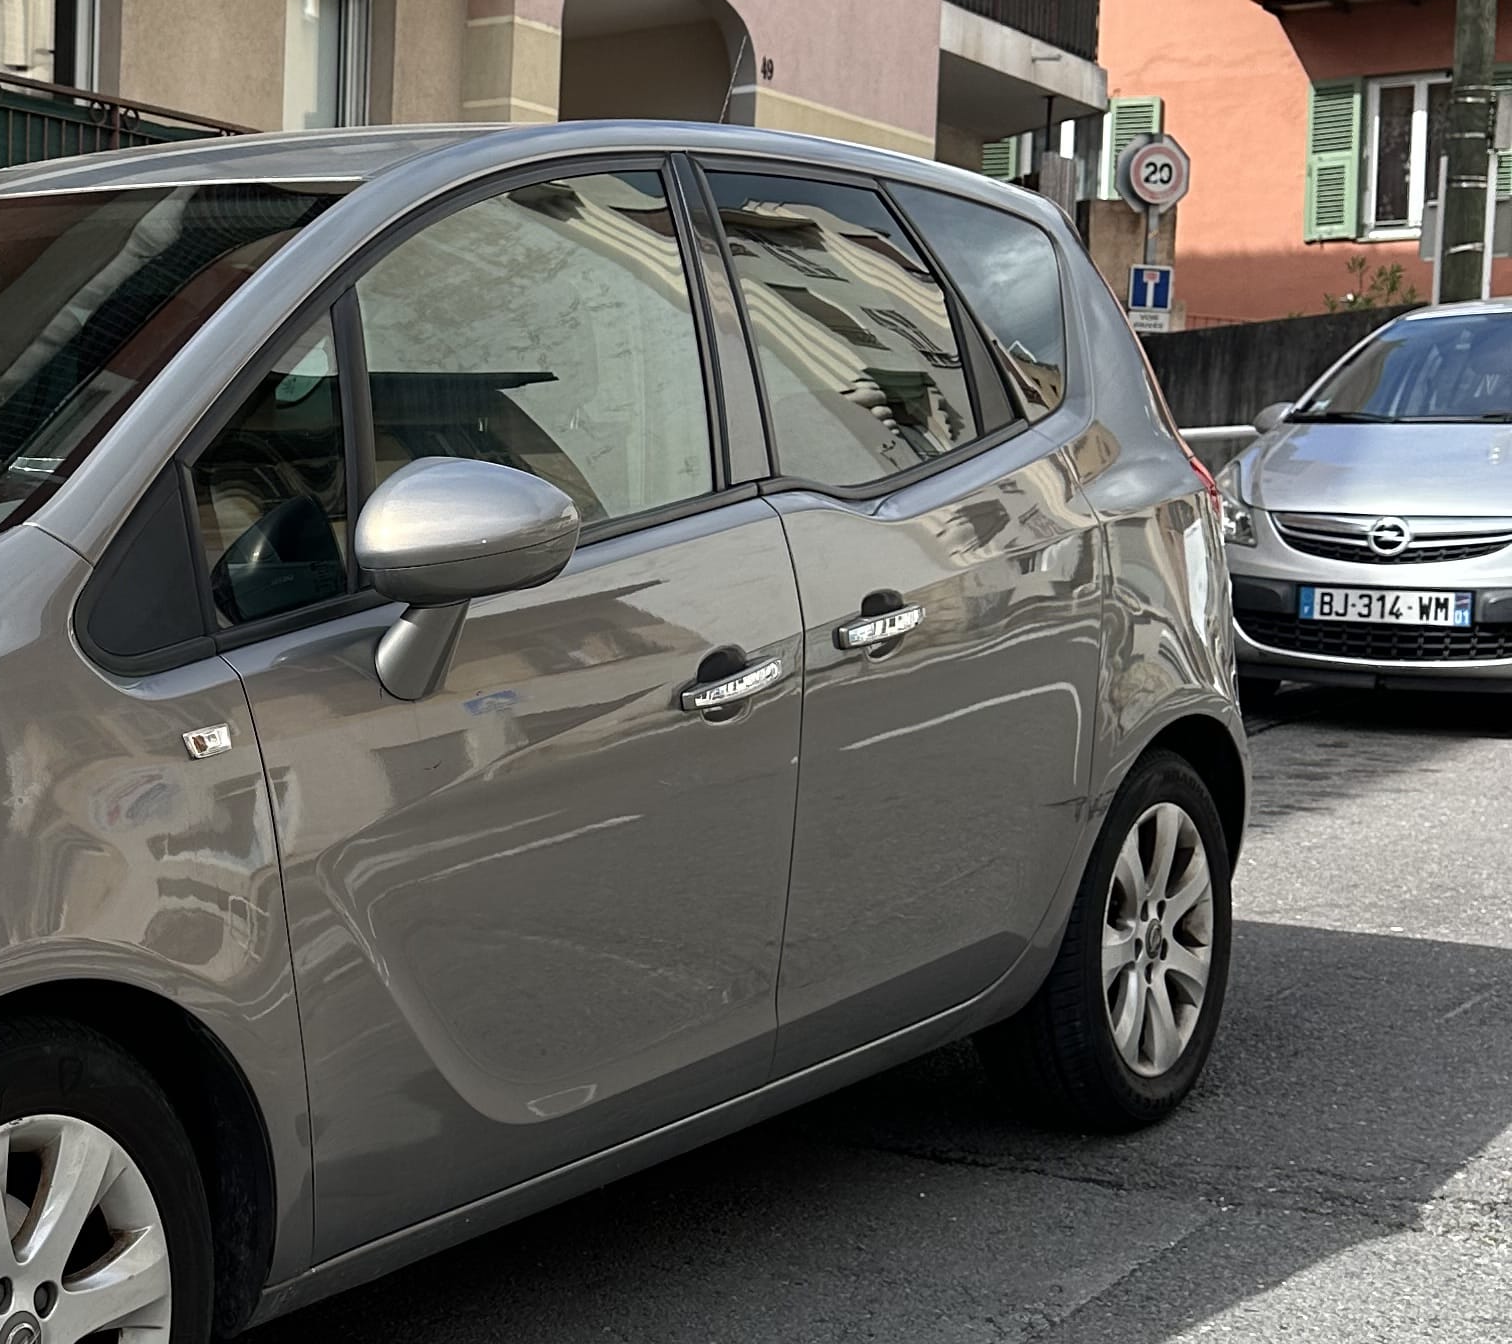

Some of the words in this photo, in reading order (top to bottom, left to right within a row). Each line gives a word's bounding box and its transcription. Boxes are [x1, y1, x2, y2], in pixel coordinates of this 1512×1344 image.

[761, 56, 775, 80] 49
[1144, 162, 1173, 184] 20
[1319, 592, 1450, 622] BJ-314-WM
[1454, 609, 1470, 625] 01
